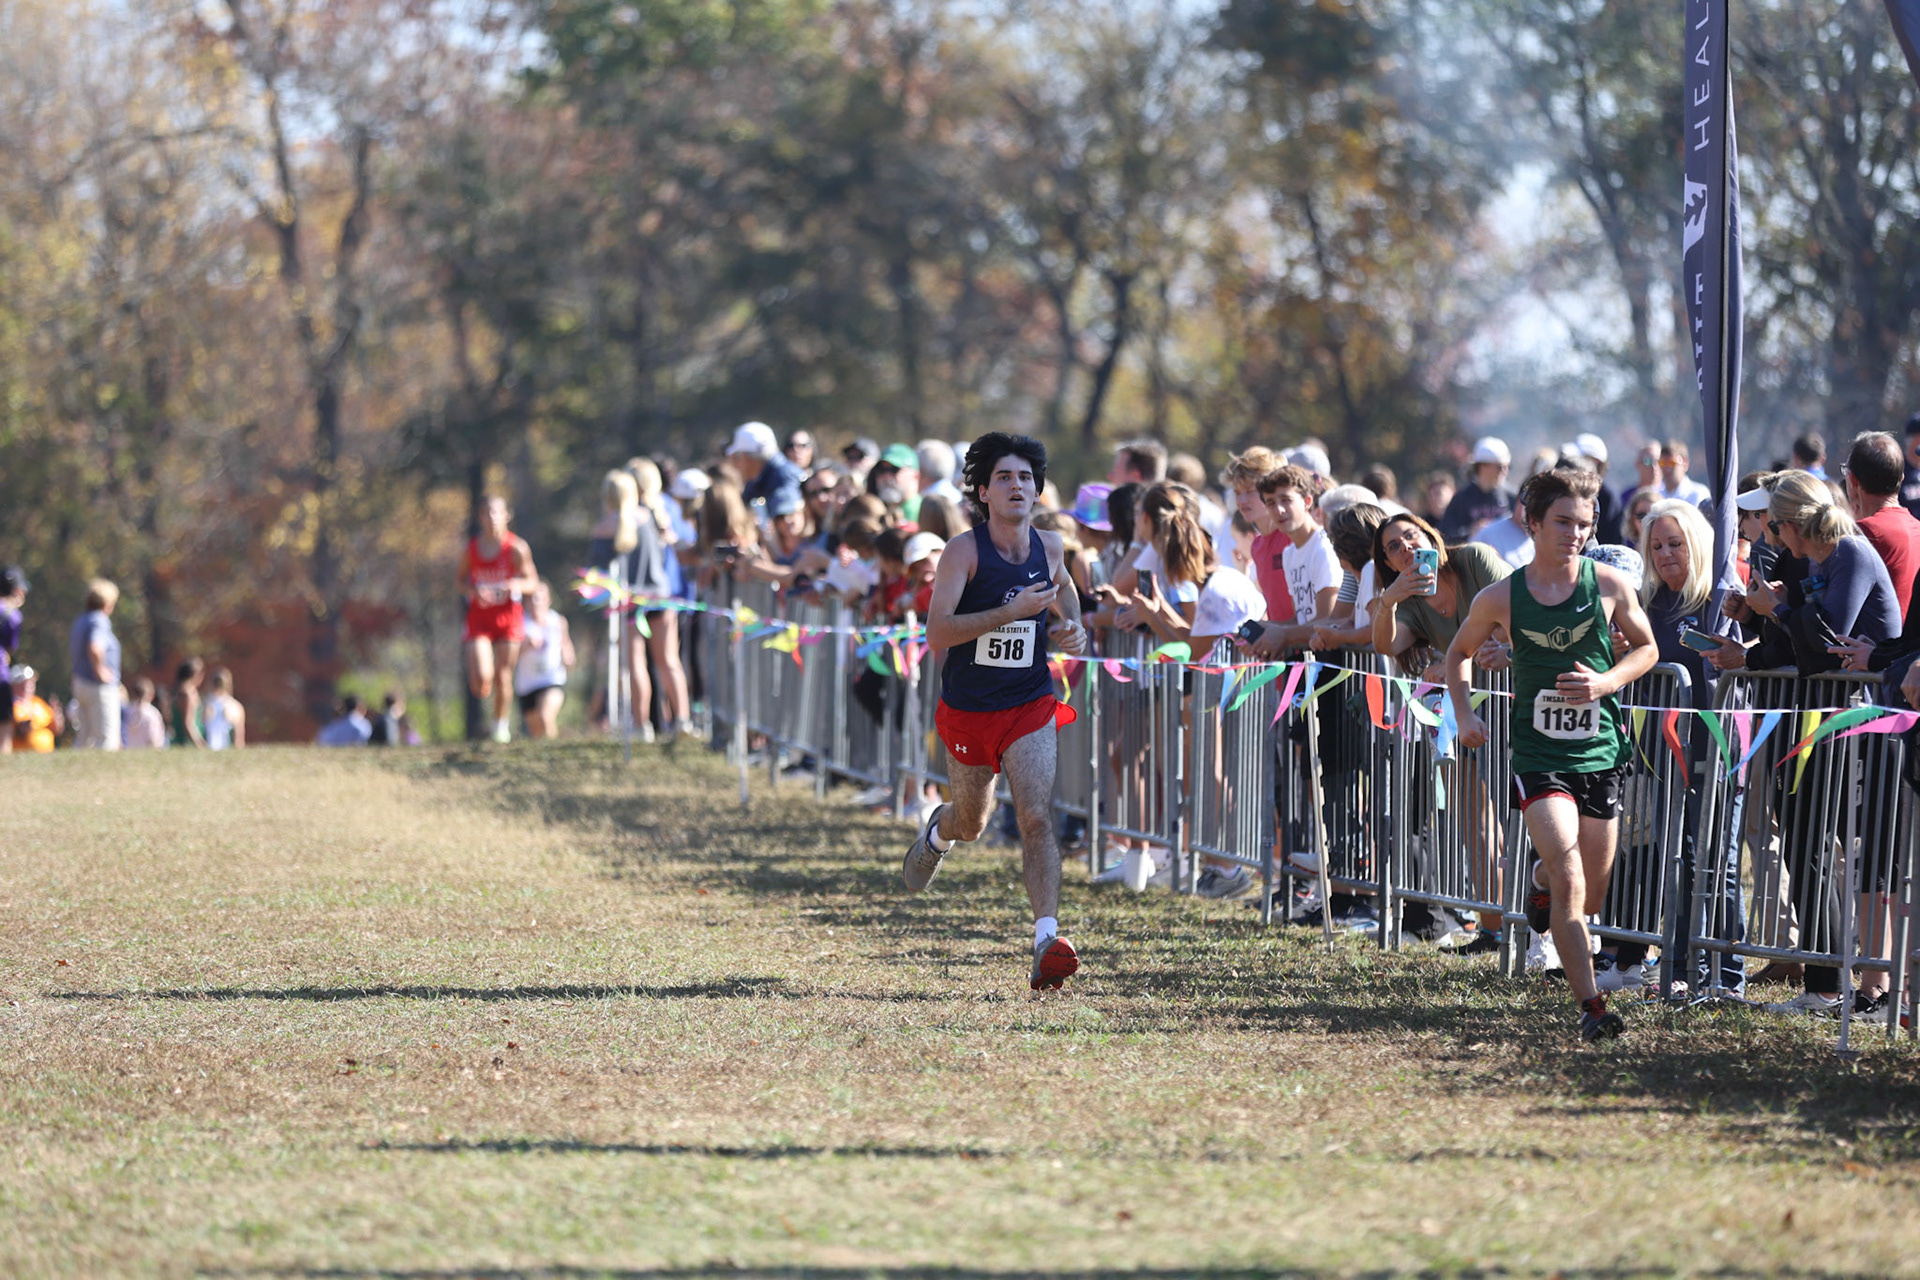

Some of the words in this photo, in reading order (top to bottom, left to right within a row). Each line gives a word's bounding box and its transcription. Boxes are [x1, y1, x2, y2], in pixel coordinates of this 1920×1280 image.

[1694, 0, 1710, 152] HEAL
[988, 638, 1024, 660] 518
[1541, 707, 1592, 732] 1134
